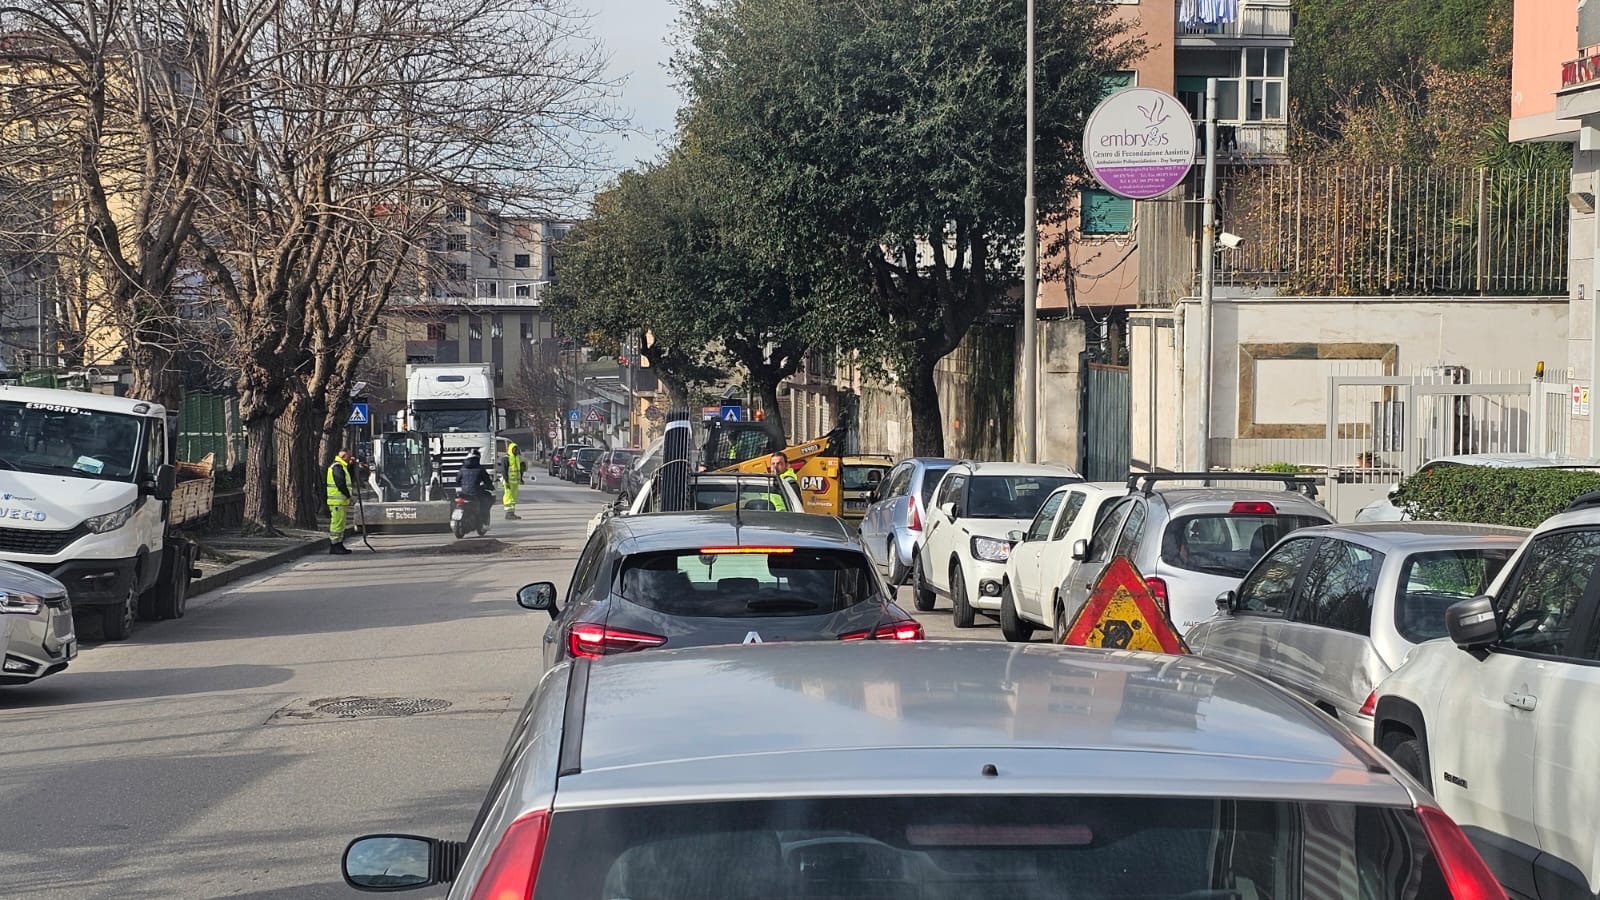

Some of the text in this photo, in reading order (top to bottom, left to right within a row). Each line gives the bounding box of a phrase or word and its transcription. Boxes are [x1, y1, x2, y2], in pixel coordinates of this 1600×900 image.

[1101, 128, 1169, 147] embryos
[1093, 147, 1190, 158] Centro di Fecondazione Assistita
[25, 402, 79, 414] ESPOSITO
[801, 476, 824, 490] CAT
